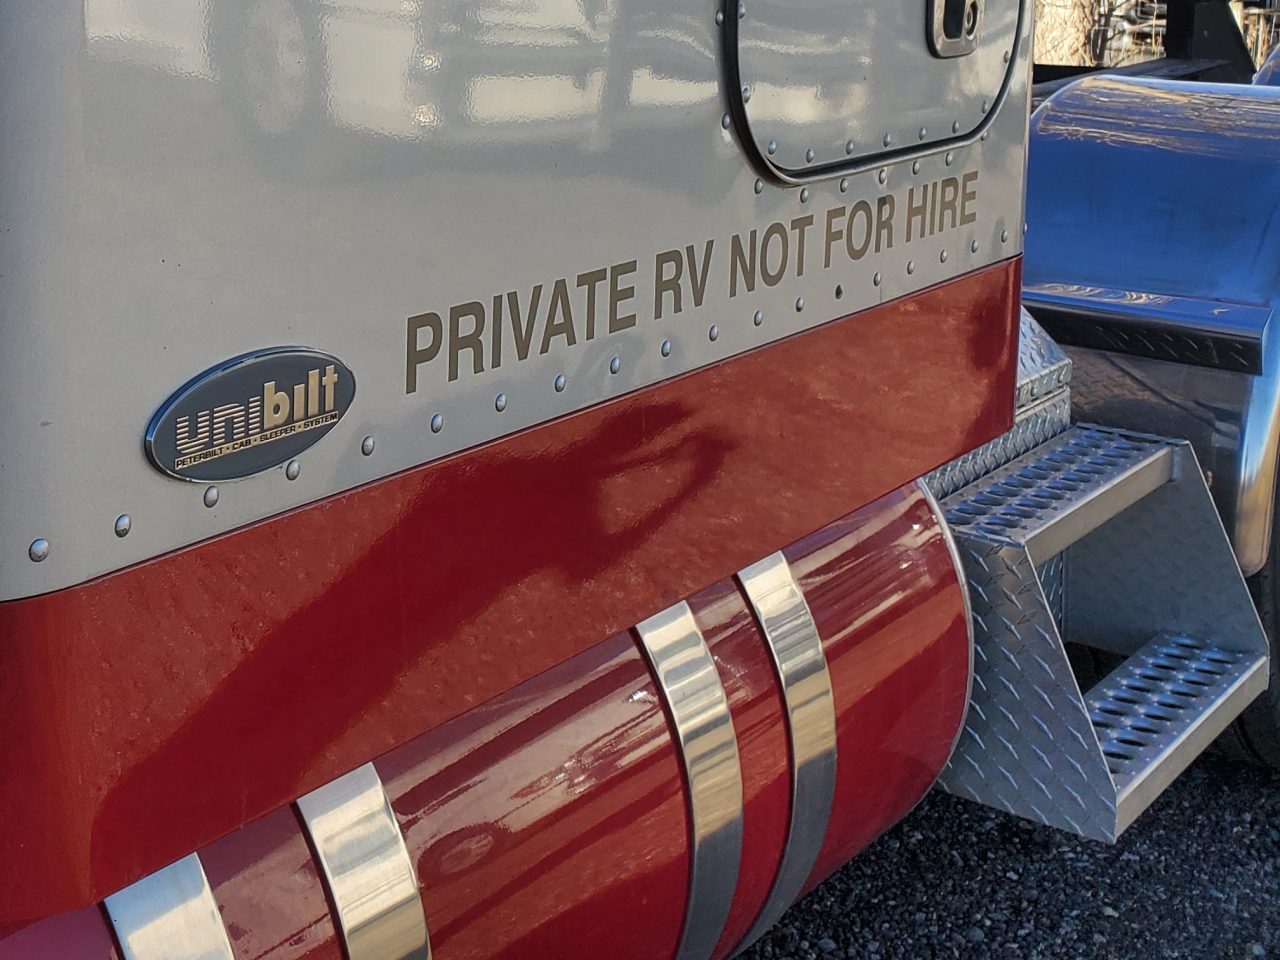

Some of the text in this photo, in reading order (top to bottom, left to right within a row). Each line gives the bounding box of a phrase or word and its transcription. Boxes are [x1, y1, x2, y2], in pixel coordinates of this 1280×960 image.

[405, 170, 979, 396] PRIVATE RV NOT FOR HIRE
[176, 412, 339, 469] PETERBILT CAB SLEEPER SYSTEM
